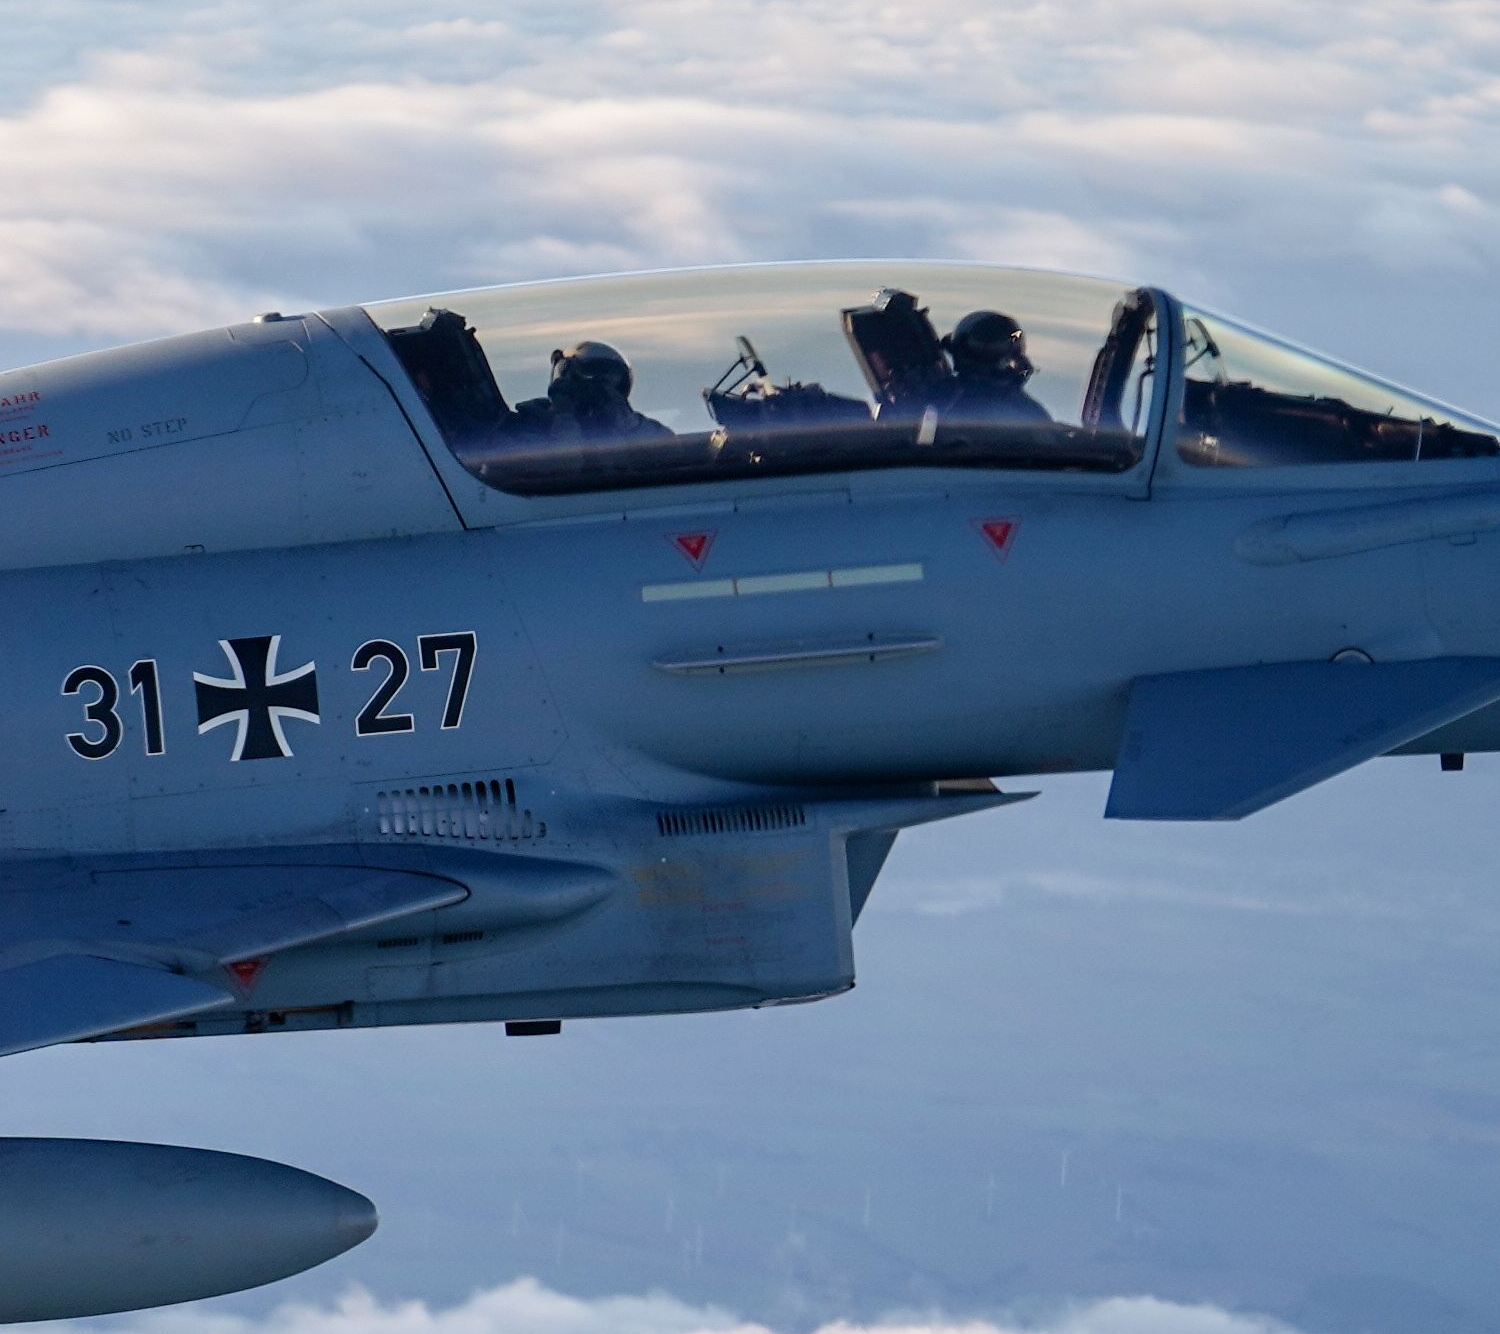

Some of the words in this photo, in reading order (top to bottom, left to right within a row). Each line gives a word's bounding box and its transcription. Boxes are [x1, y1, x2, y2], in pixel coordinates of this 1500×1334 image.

[107, 428, 132, 444] NO
[141, 417, 188, 438] STEP
[61, 658, 166, 760] 31
[350, 631, 477, 737] 27
